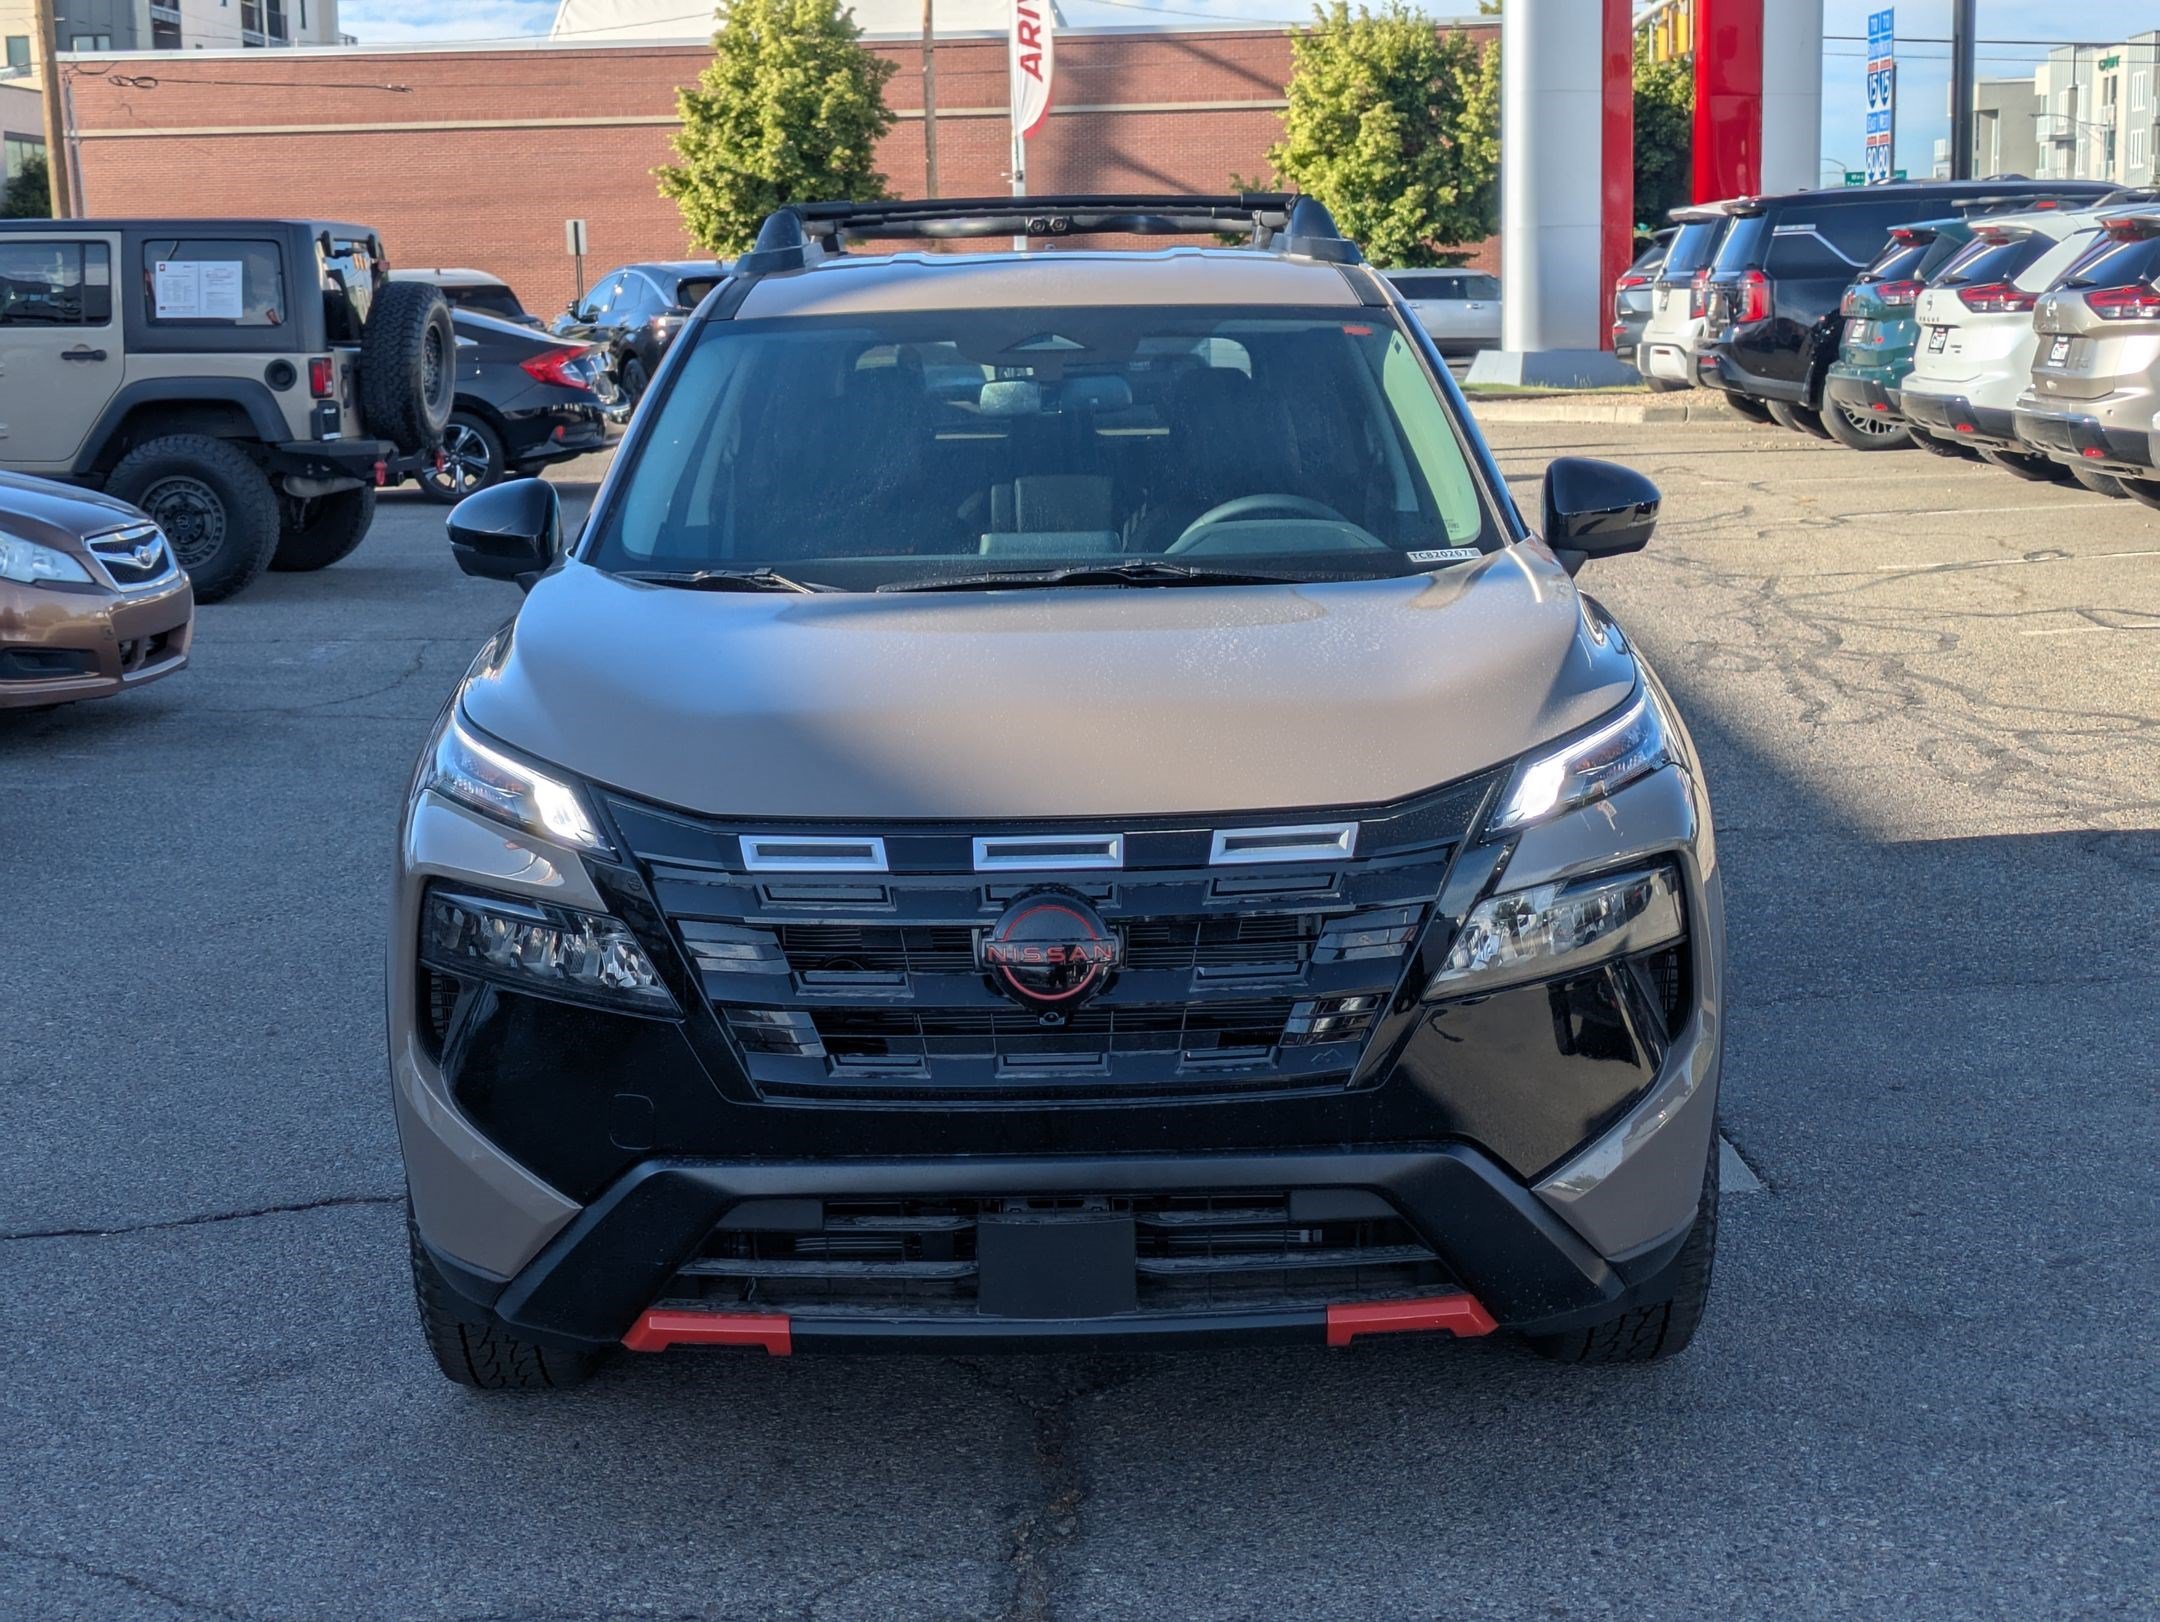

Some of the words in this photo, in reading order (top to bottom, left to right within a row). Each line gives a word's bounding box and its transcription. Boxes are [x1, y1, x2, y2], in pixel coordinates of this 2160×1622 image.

[1017, 0, 1043, 83] ARI
[1869, 73, 1878, 101] 15
[1881, 71, 1890, 98] 15
[1867, 147, 1877, 173] 80
[1879, 145, 1889, 171] 80
[987, 944, 1114, 964] NISSAN
